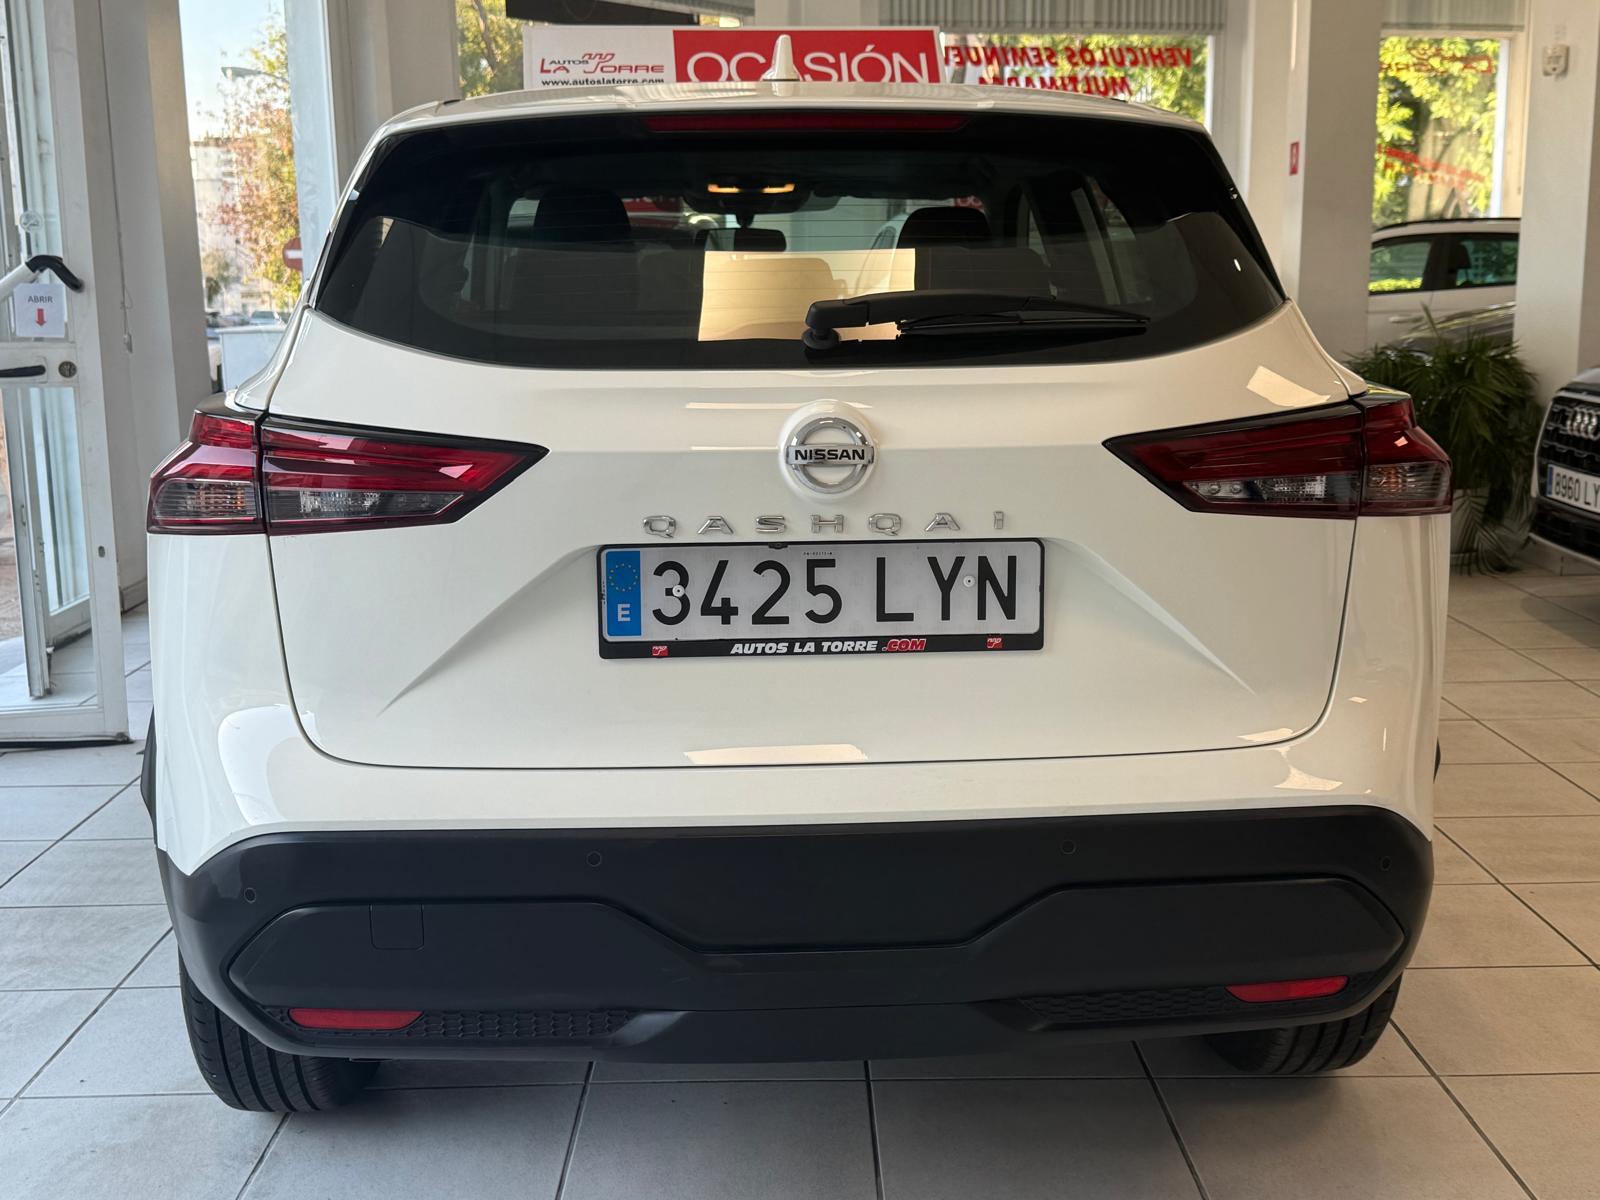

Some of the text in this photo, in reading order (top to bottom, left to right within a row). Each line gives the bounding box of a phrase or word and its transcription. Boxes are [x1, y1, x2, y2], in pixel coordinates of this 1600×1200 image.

[540, 58, 570, 73] LA
[687, 44, 929, 82] OCSIÓN
[541, 78, 664, 86] www.autoslatorrecom
[27, 295, 54, 303] ABRIR
[794, 449, 865, 461] NISSAN
[1554, 472, 1580, 502] 8960
[643, 511, 1004, 539] QASHQAI
[617, 604, 630, 621] E
[652, 558, 842, 627] 3425
[876, 555, 1017, 622] LYN
[730, 638, 926, 655] AUTOS LA TORRE .COM
